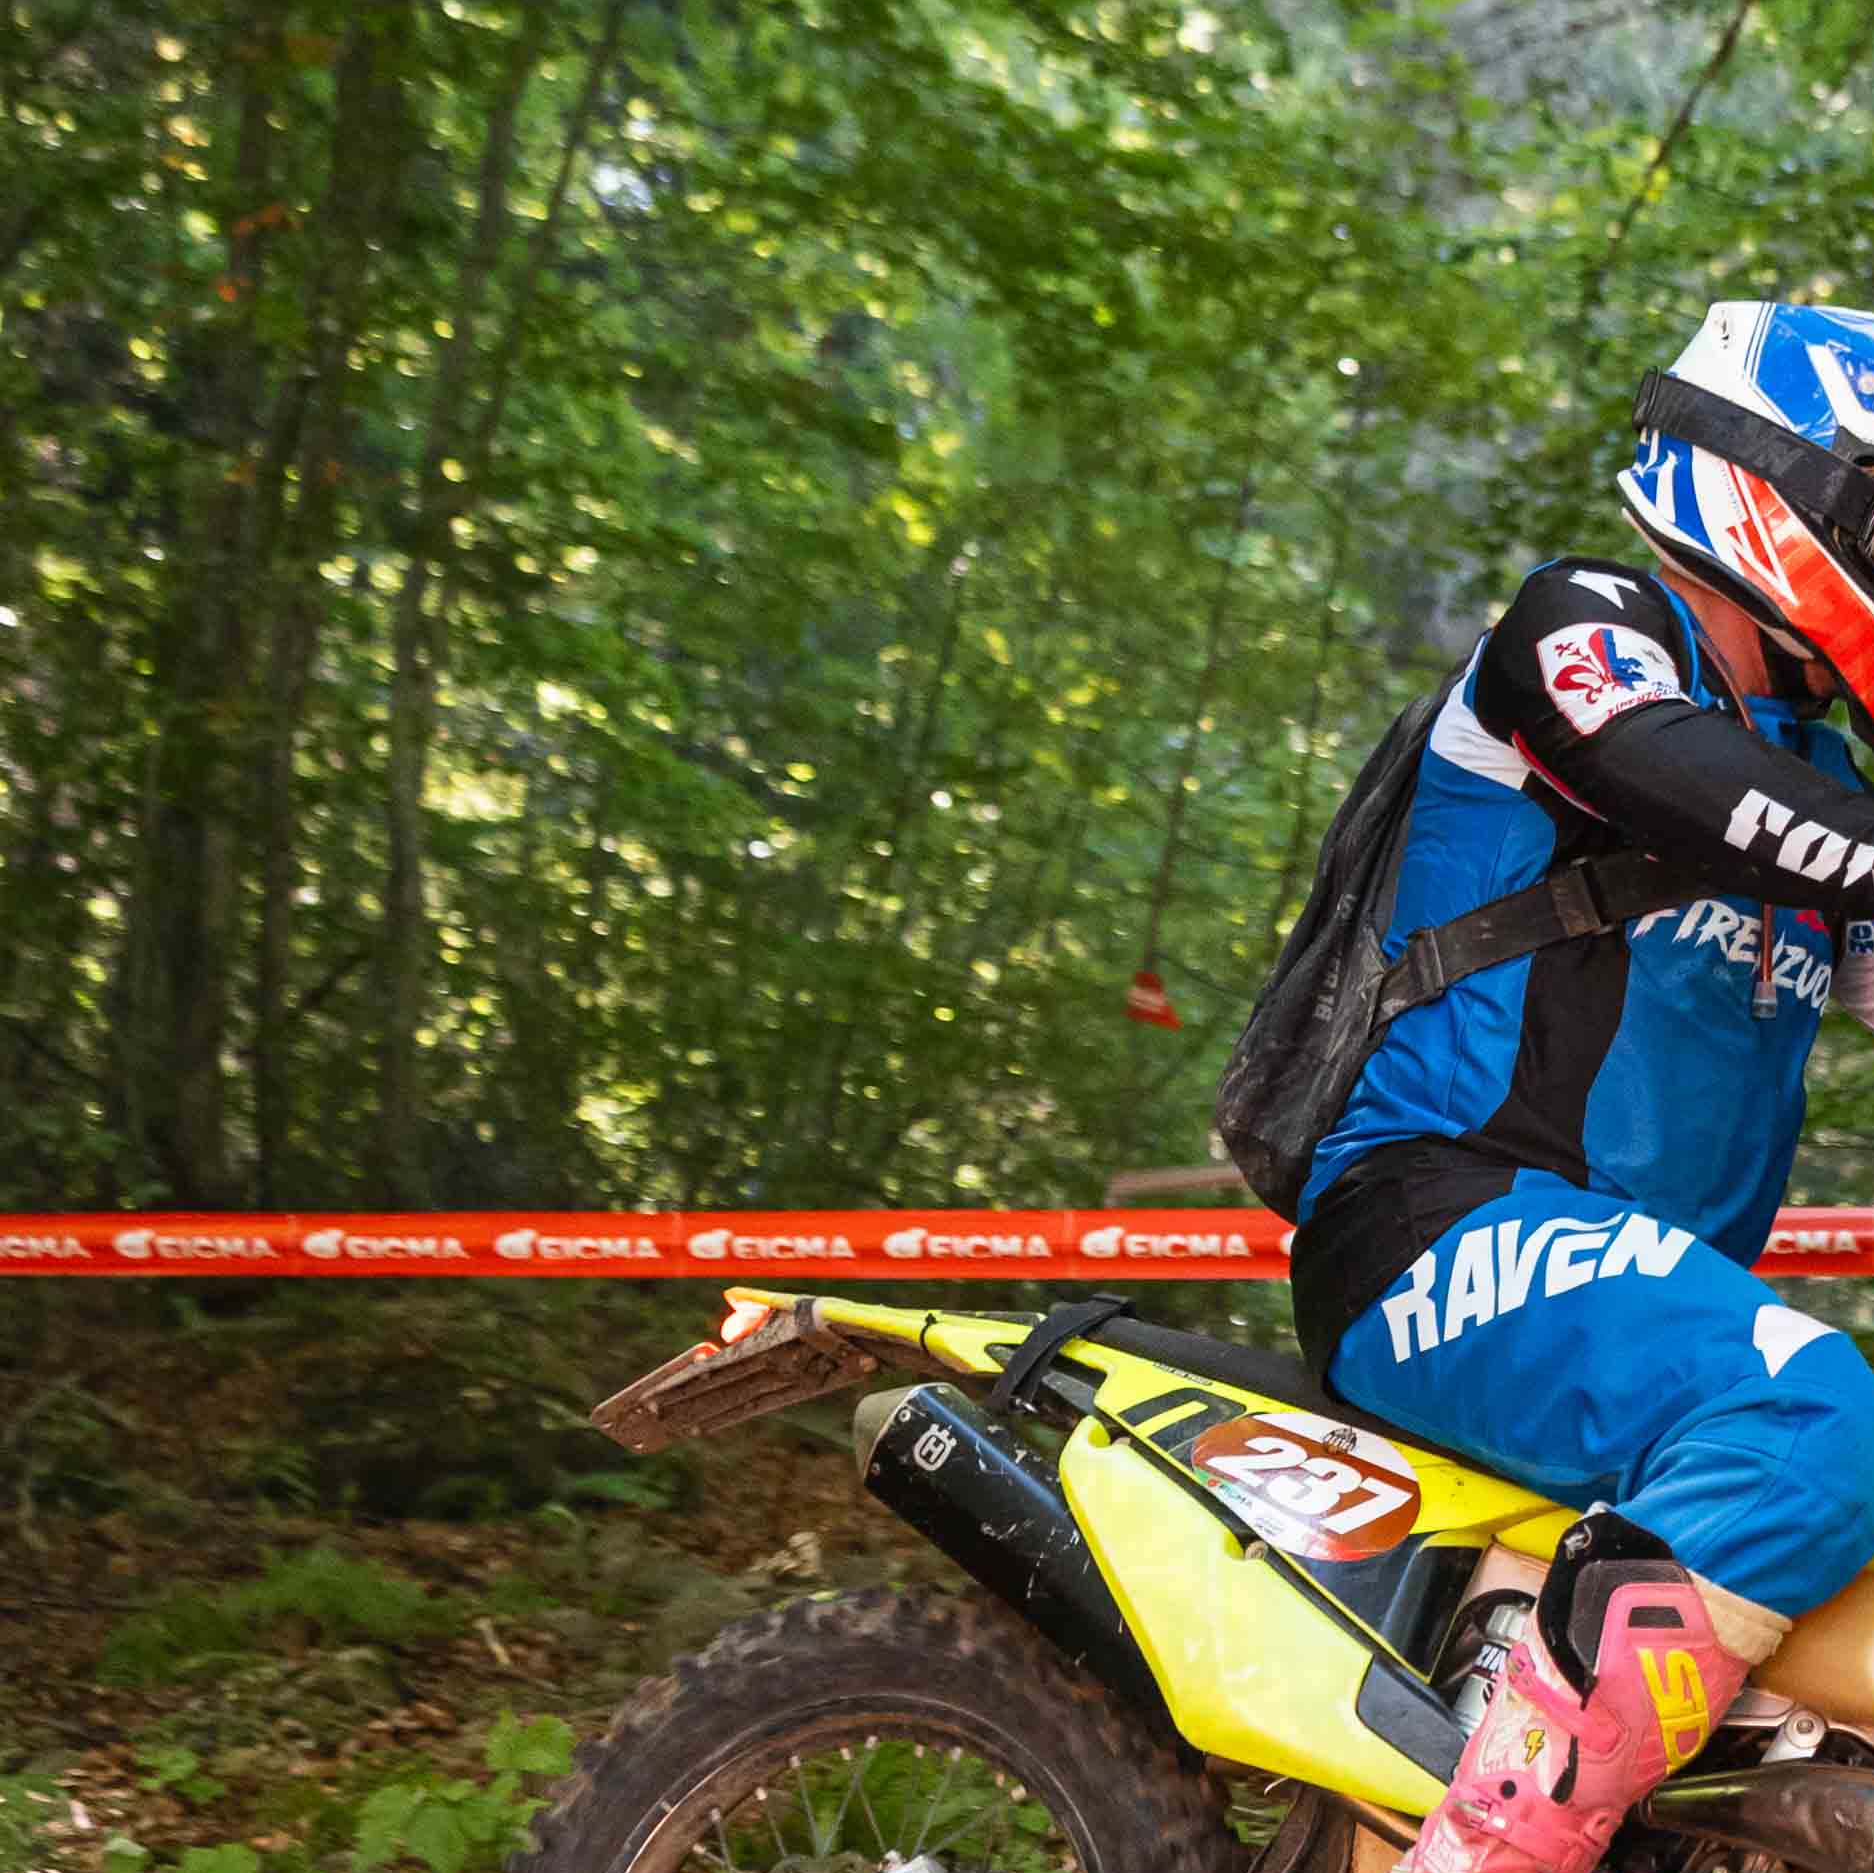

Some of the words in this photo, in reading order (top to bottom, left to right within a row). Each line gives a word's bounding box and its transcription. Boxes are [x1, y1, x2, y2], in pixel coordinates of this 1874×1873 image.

[156, 1236, 281, 1259] EICMA
[345, 1236, 470, 1259] EICMA
[538, 1235, 661, 1260] EICMA
[739, 1234, 855, 1260] EICMA
[925, 1233, 1053, 1259] EICMA
[1123, 1233, 1251, 1258] EICMA
[1380, 1212, 1697, 1364] RAVEN
[1205, 1435, 1414, 1535] 237
